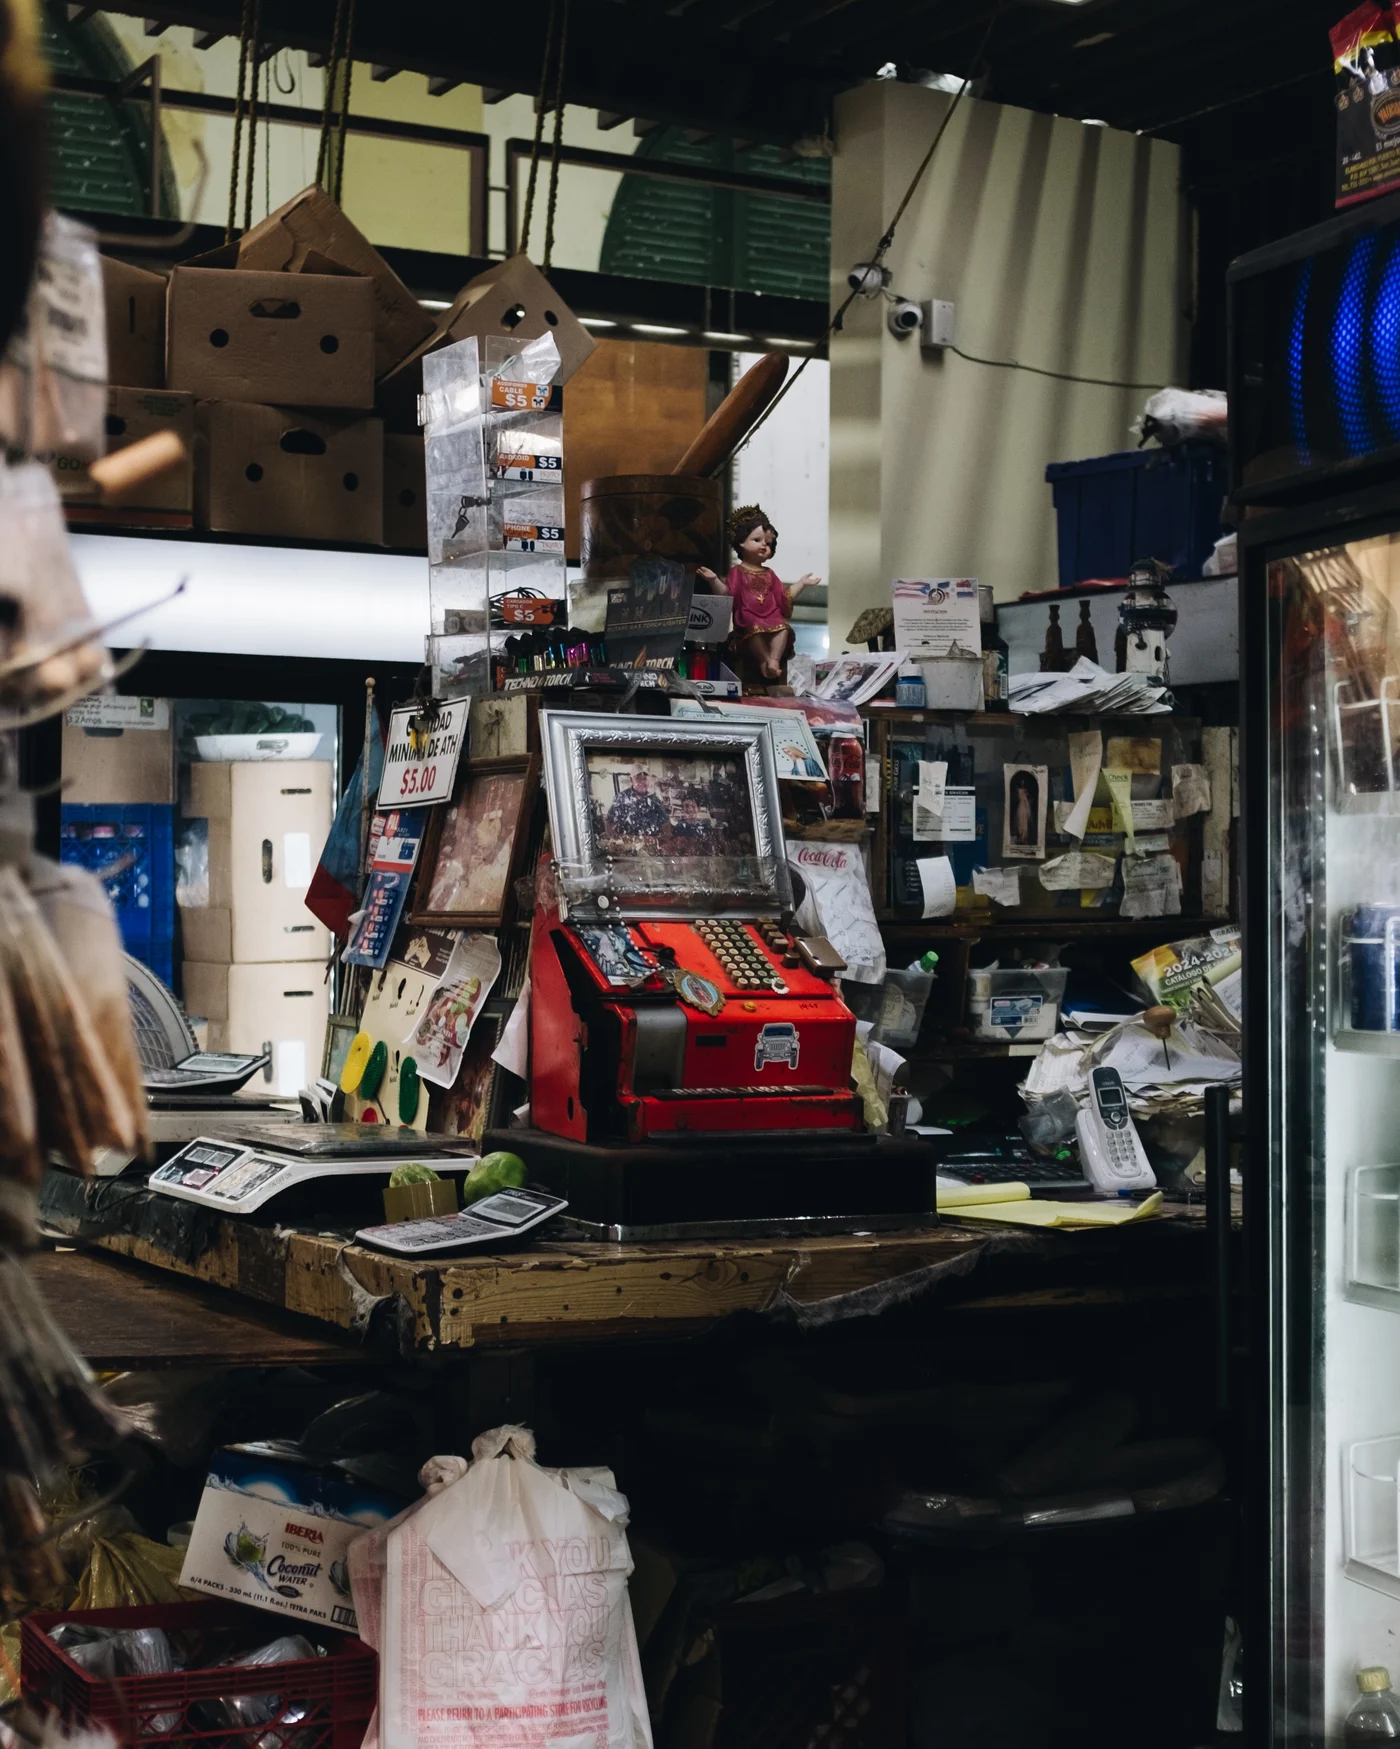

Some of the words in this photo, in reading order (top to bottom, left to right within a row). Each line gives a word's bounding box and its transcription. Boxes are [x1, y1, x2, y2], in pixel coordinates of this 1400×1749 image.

[499, 386, 523, 395] CABLE
[505, 393, 527, 407] $5
[538, 457, 557, 468] $5
[504, 524, 531, 532] IPHONE
[541, 528, 560, 539] $5
[514, 609, 535, 621] $5
[689, 612, 709, 623] INK
[504, 676, 538, 691] TECHNO
[543, 673, 573, 687] TORCH
[623, 672, 658, 681] TCHNO
[406, 711, 452, 737] CIDAD
[388, 742, 425, 764] MINIM
[427, 737, 440, 759] DE
[439, 733, 459, 756] ATH
[400, 765, 437, 796] $5.00
[1108, 773, 1129, 781] Check
[739, 1085, 801, 1094] VIBRA
[285, 1523, 325, 1546] IBERIA
[281, 1541, 301, 1552] 100%
[302, 1547, 322, 1559] PURE
[540, 1537, 611, 1577] YOU
[267, 1555, 323, 1577] Coconut
[278, 1574, 308, 1586] WATER
[190, 1576, 202, 1584] 6/4
[203, 1579, 224, 1591] PACKS
[229, 1586, 242, 1595] 330
[289, 1602, 308, 1614] TETRA
[309, 1607, 327, 1619] PAKS
[419, 1573, 609, 1615] GRCIAS
[425, 1611, 543, 1651] THANK
[547, 1605, 609, 1648] YOU
[419, 1641, 606, 1688] GRACIAS
[418, 1708, 445, 1721] PLEASE
[474, 1707, 485, 1720] TO
[486, 1708, 493, 1720] A
[494, 1704, 549, 1720] PARTICIPATING
[550, 1702, 570, 1718] STORE
[570, 1700, 581, 1714] FOR
